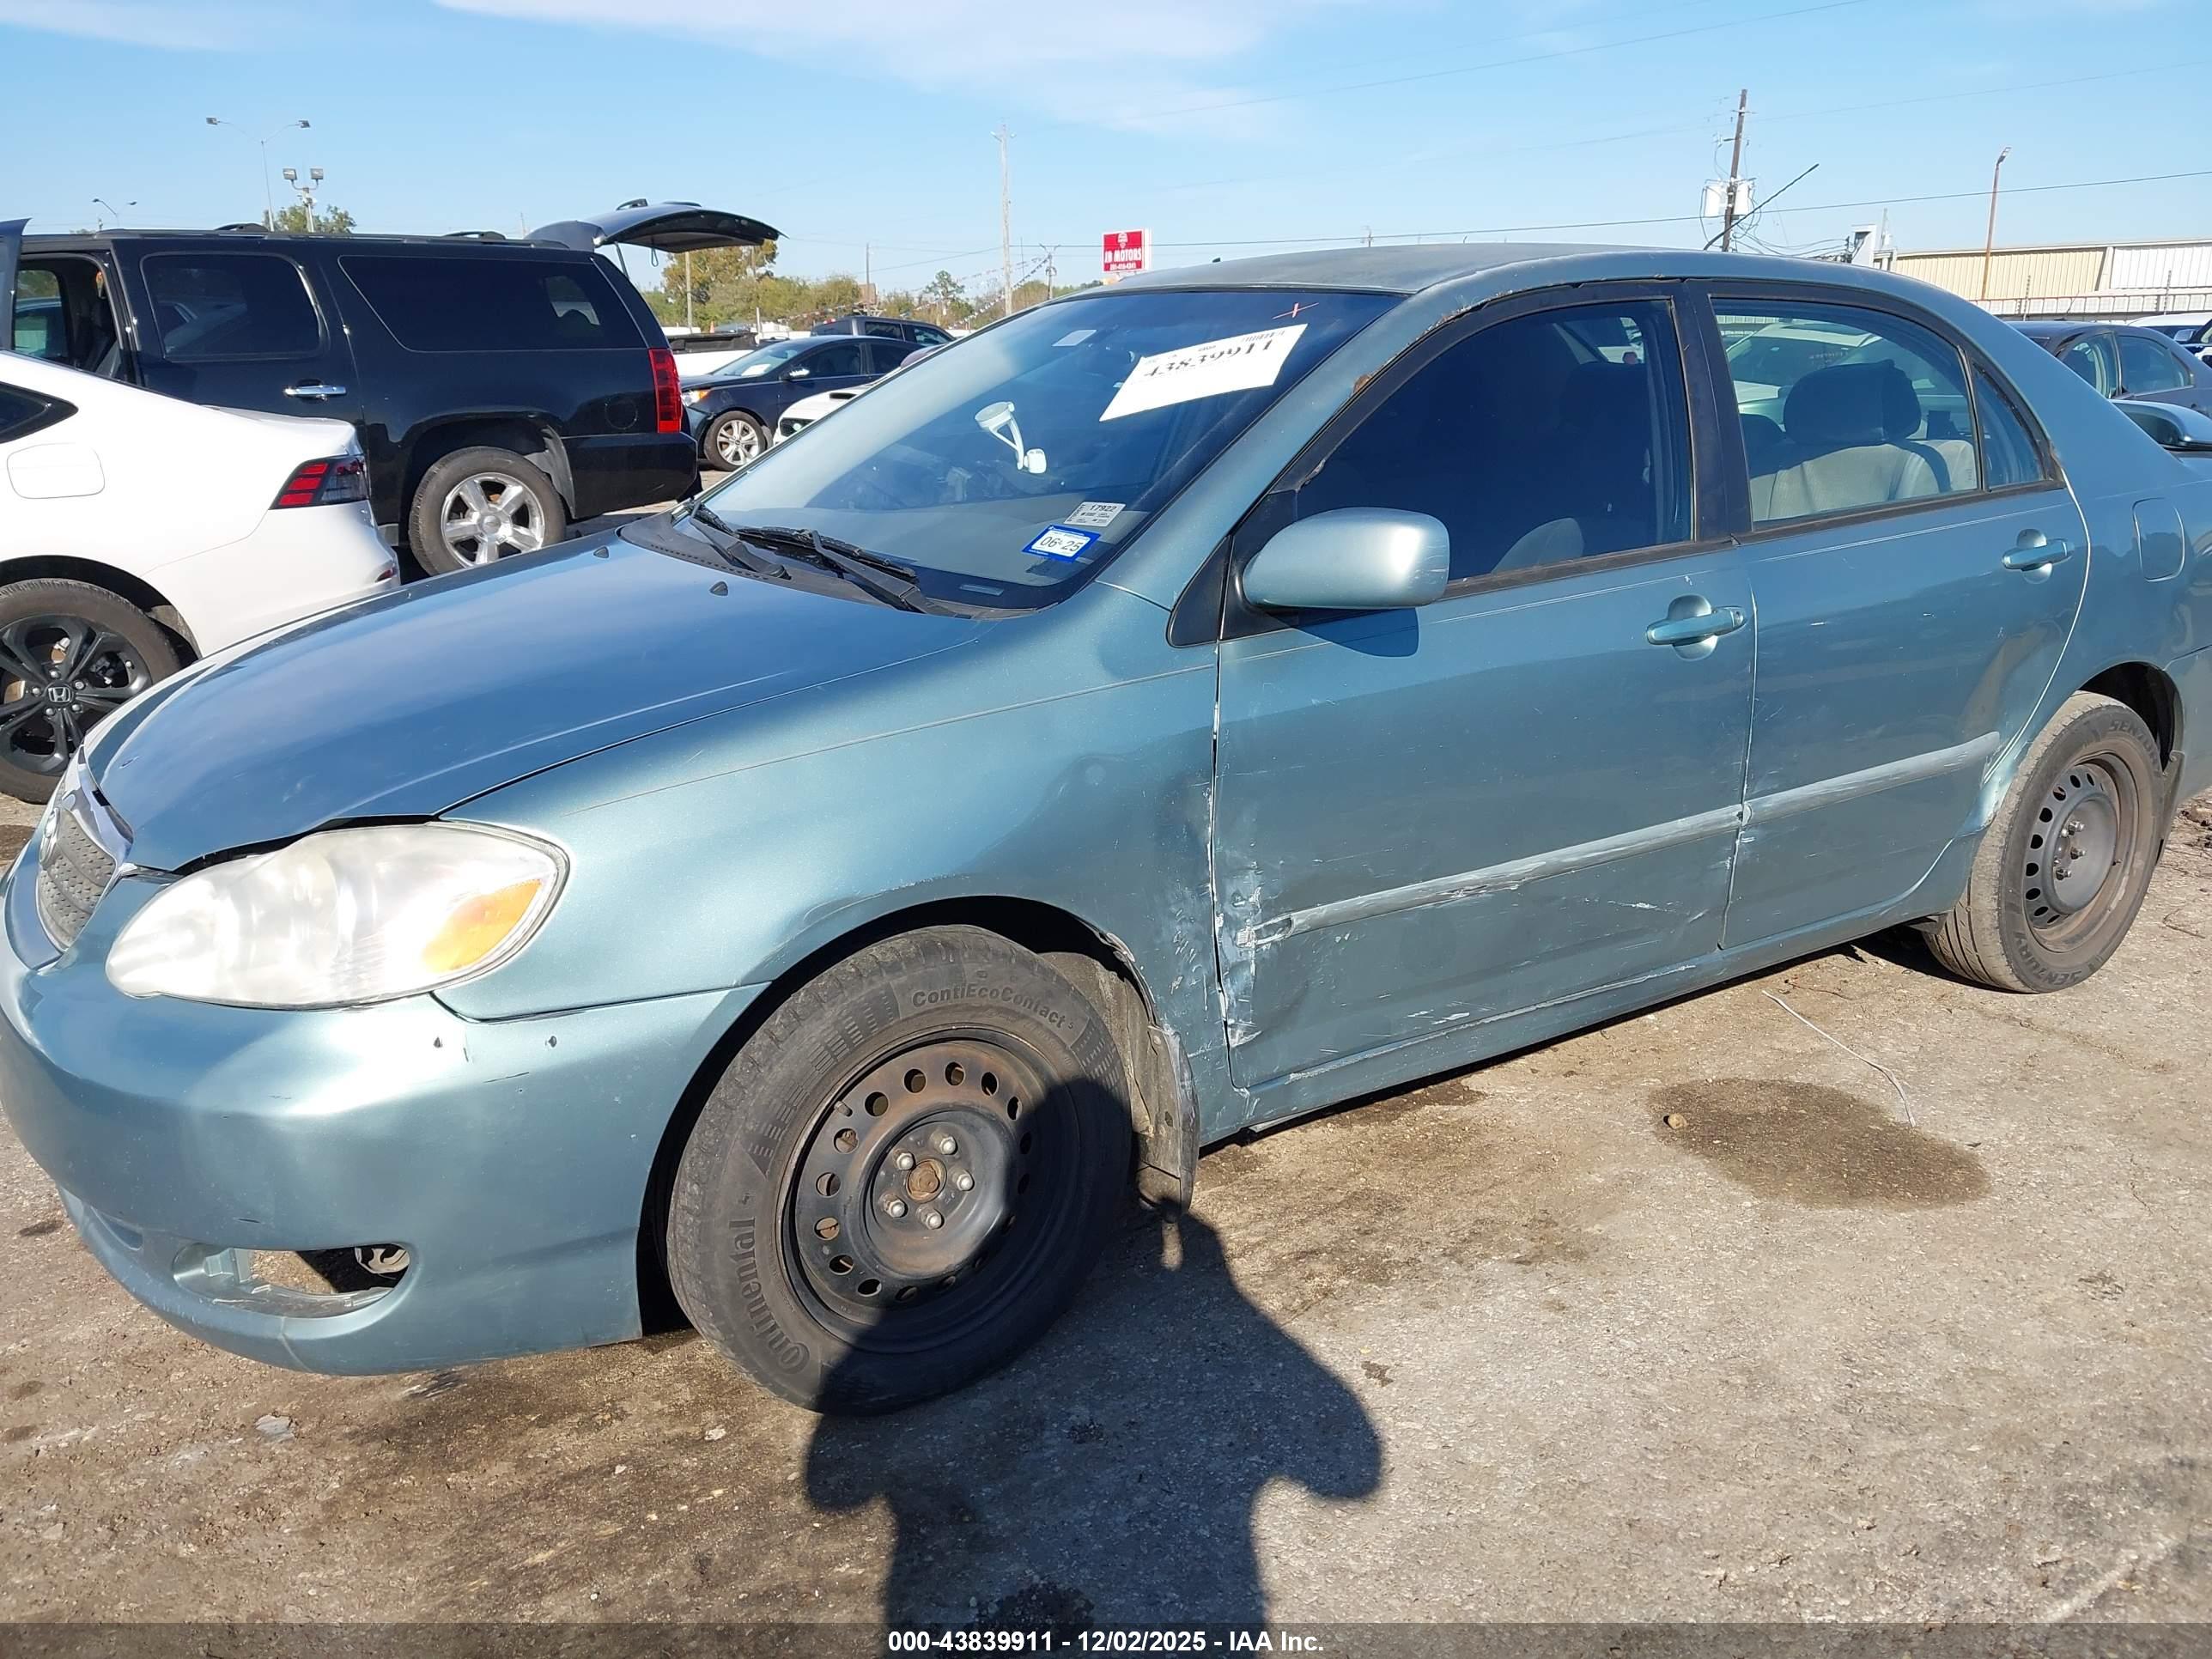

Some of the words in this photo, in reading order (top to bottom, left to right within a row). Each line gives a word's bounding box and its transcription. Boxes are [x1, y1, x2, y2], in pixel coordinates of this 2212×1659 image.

[1115, 248, 1142, 261] MOTORS
[1090, 504, 1117, 513] 17922
[1039, 536, 1061, 548] 06
[1061, 540, 1084, 552] 25
[912, 987, 1066, 1029] ContiEcoContact
[729, 1216, 811, 1375] Continental
